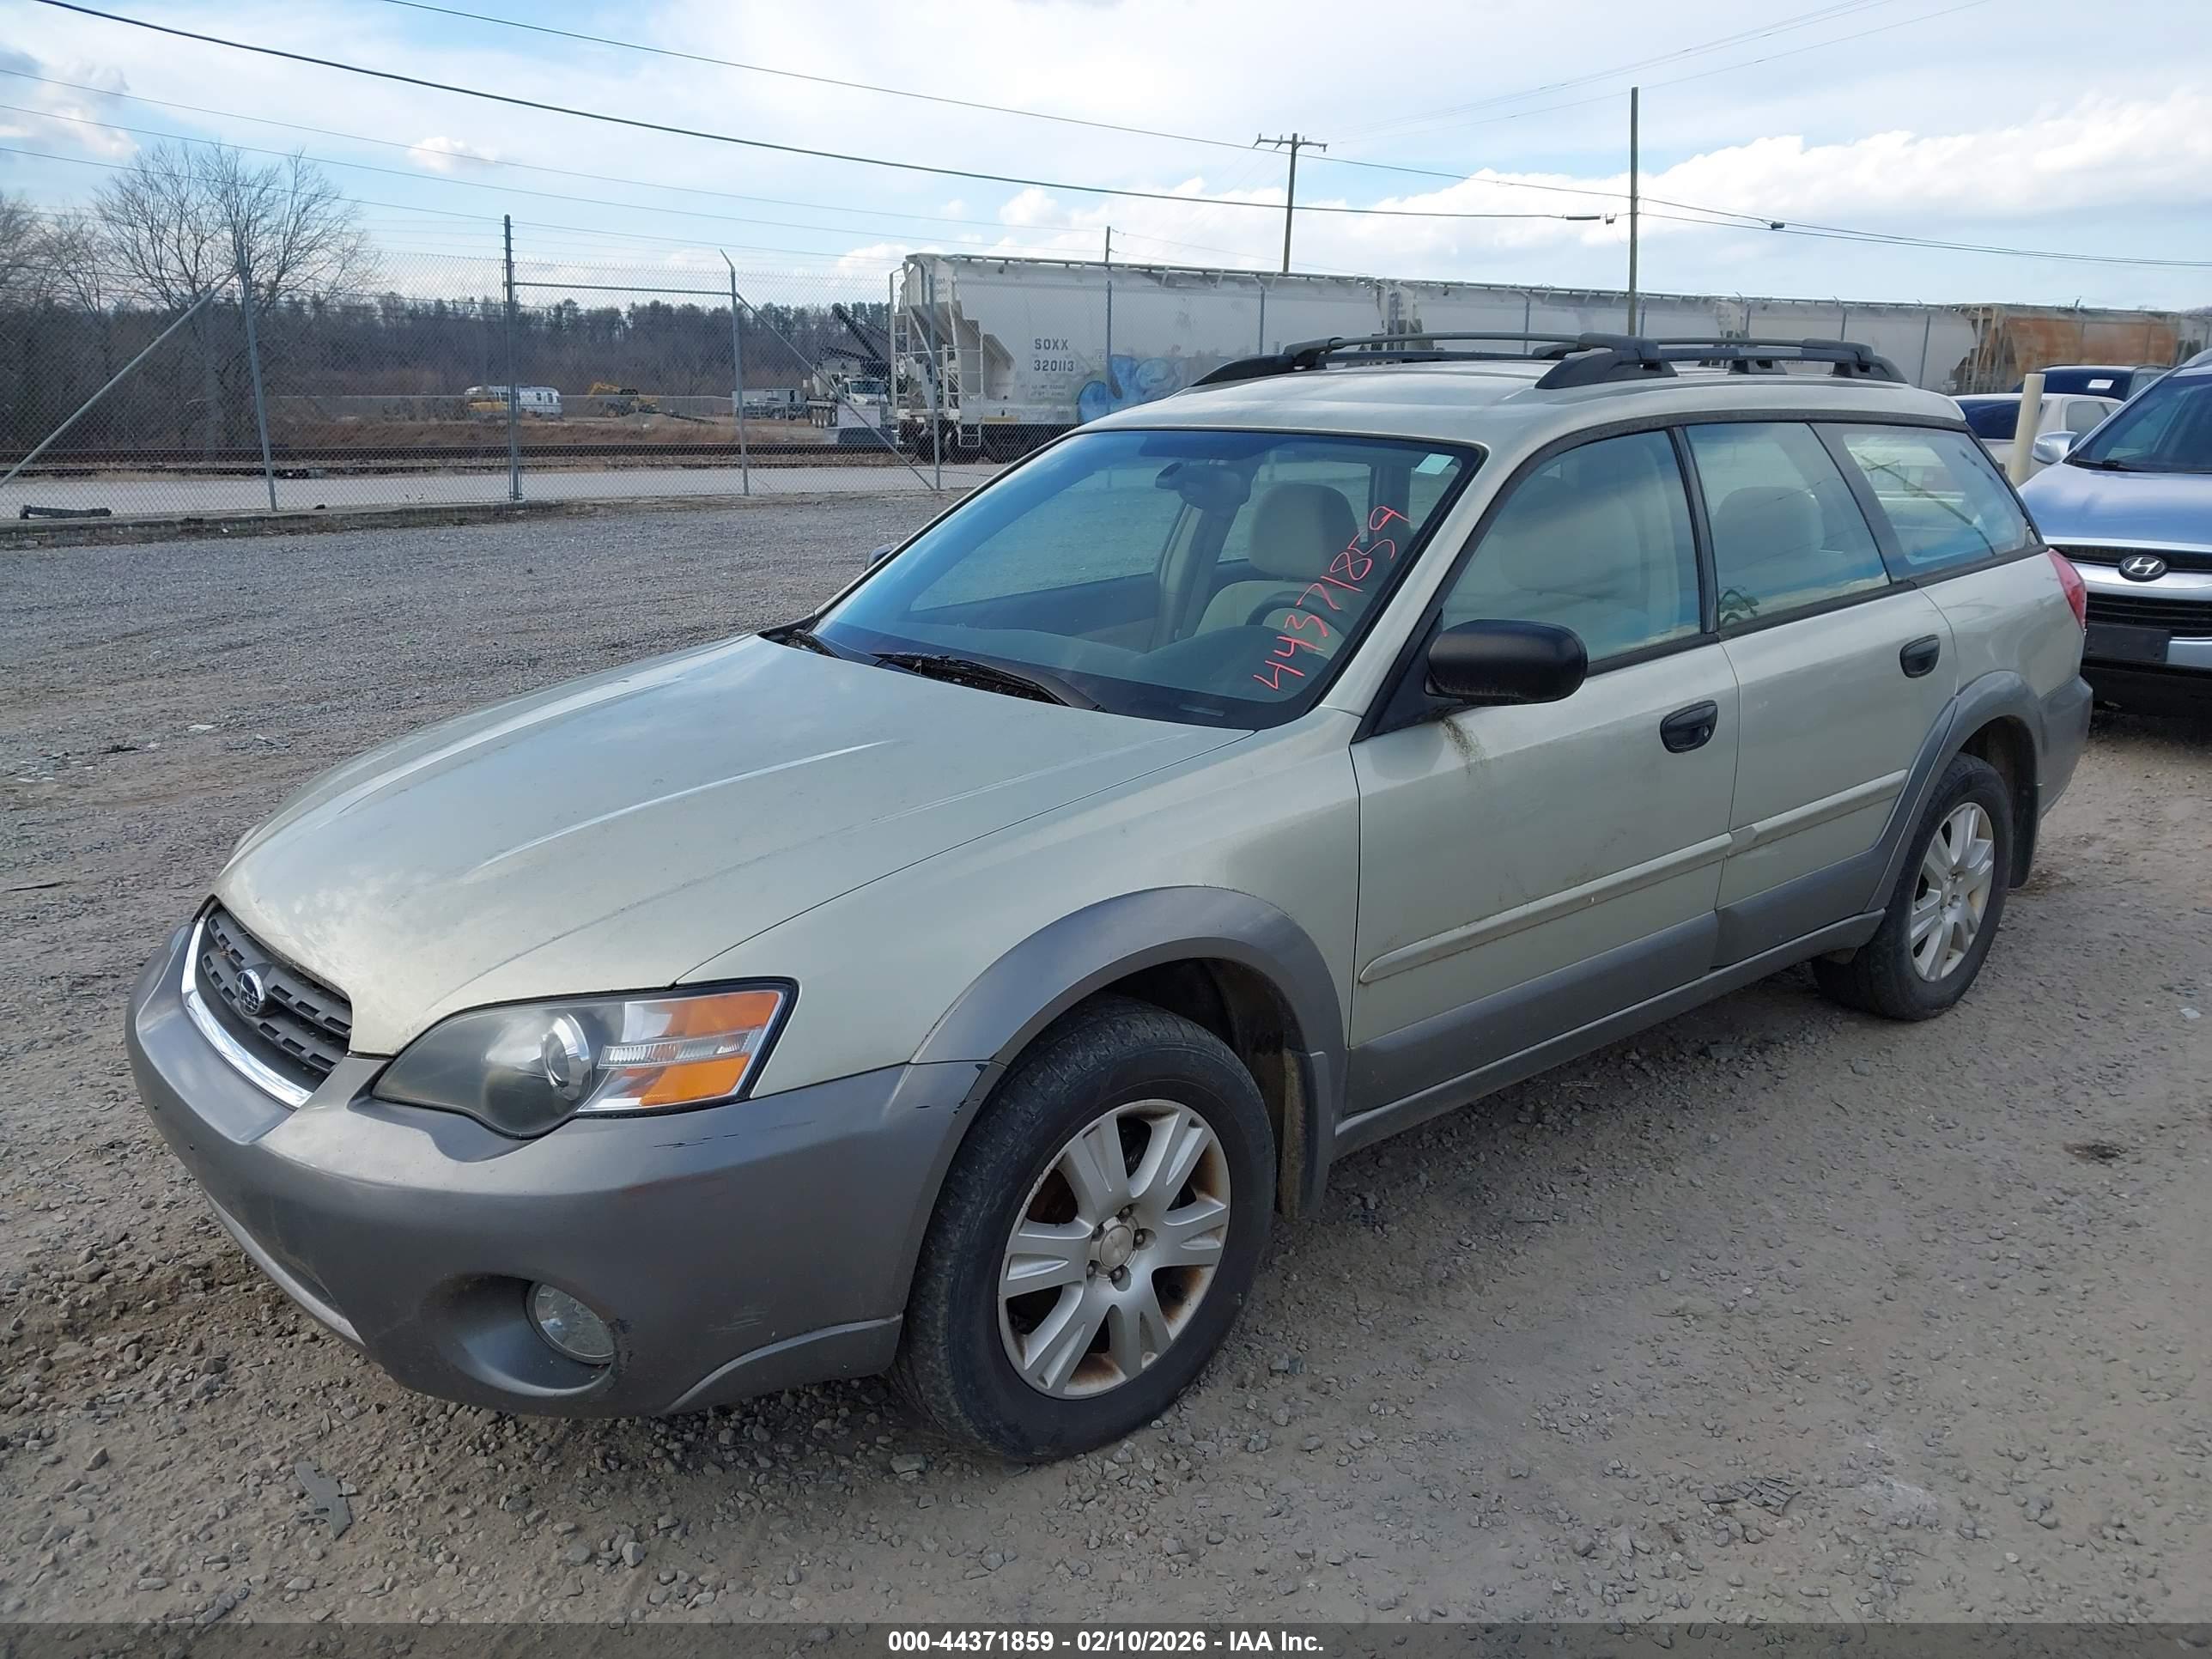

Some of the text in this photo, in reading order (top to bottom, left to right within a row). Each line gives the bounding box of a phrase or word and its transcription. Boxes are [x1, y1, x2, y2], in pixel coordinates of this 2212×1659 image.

[1034, 337, 1068, 350] SOXX
[1034, 359, 1073, 372] 320113
[1253, 505, 1411, 690] 44371859
